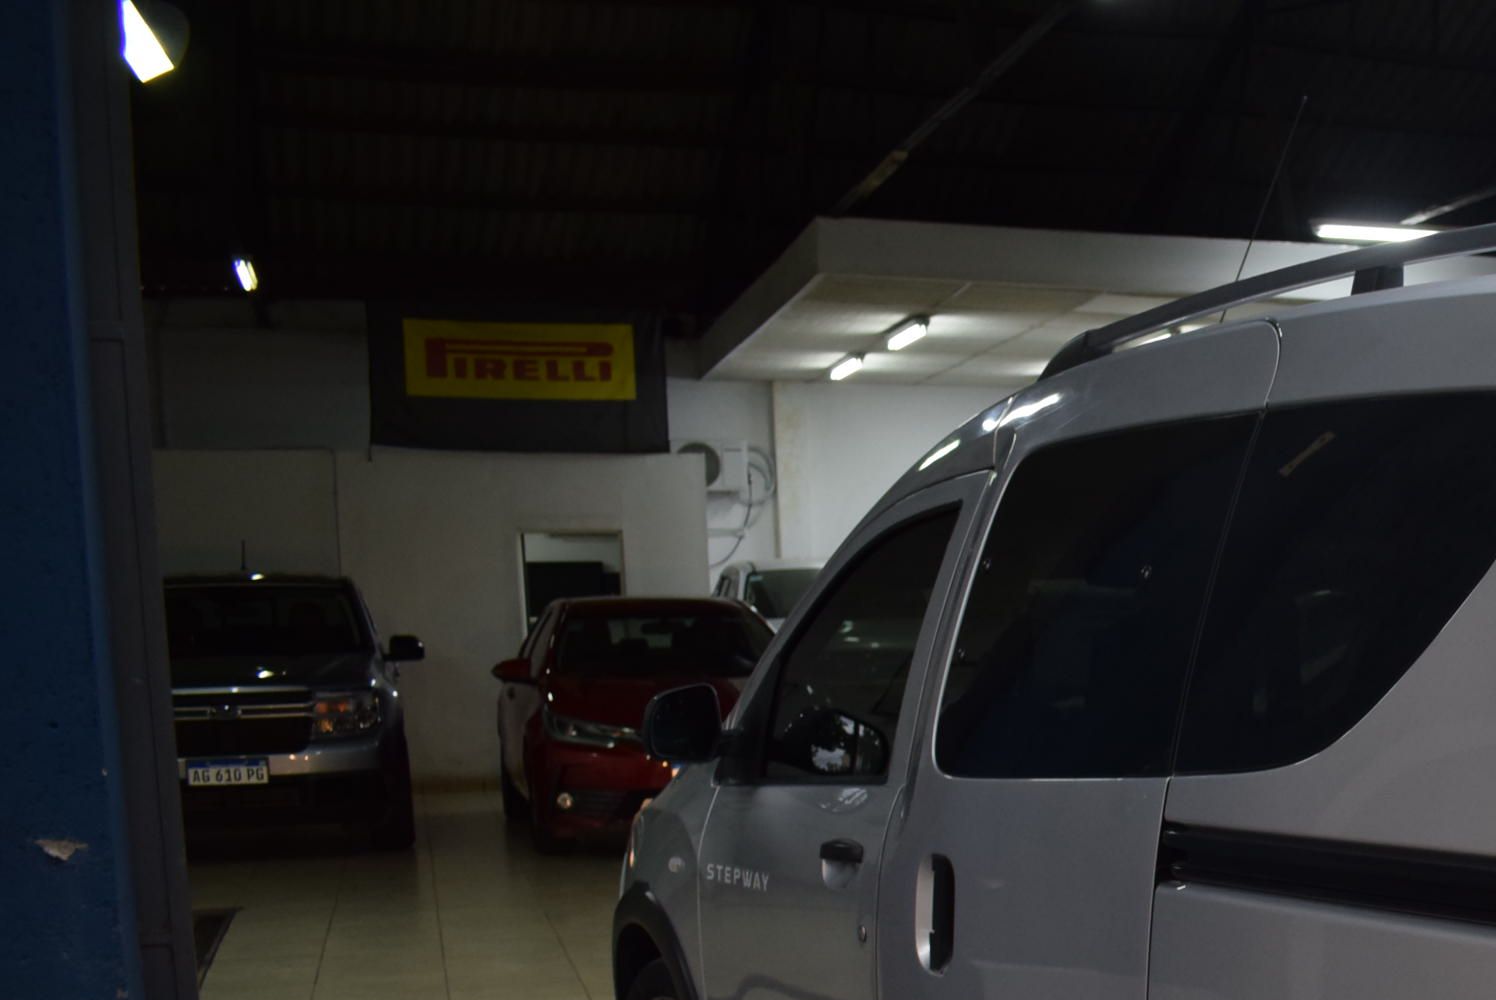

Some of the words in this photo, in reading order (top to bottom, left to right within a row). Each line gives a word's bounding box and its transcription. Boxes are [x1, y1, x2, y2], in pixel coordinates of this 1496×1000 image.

[425, 337, 614, 383] PIRELLI
[193, 768, 210, 783] AG
[215, 767, 242, 782] 610
[246, 766, 264, 781] PG
[706, 863, 769, 892] STEPWAY
